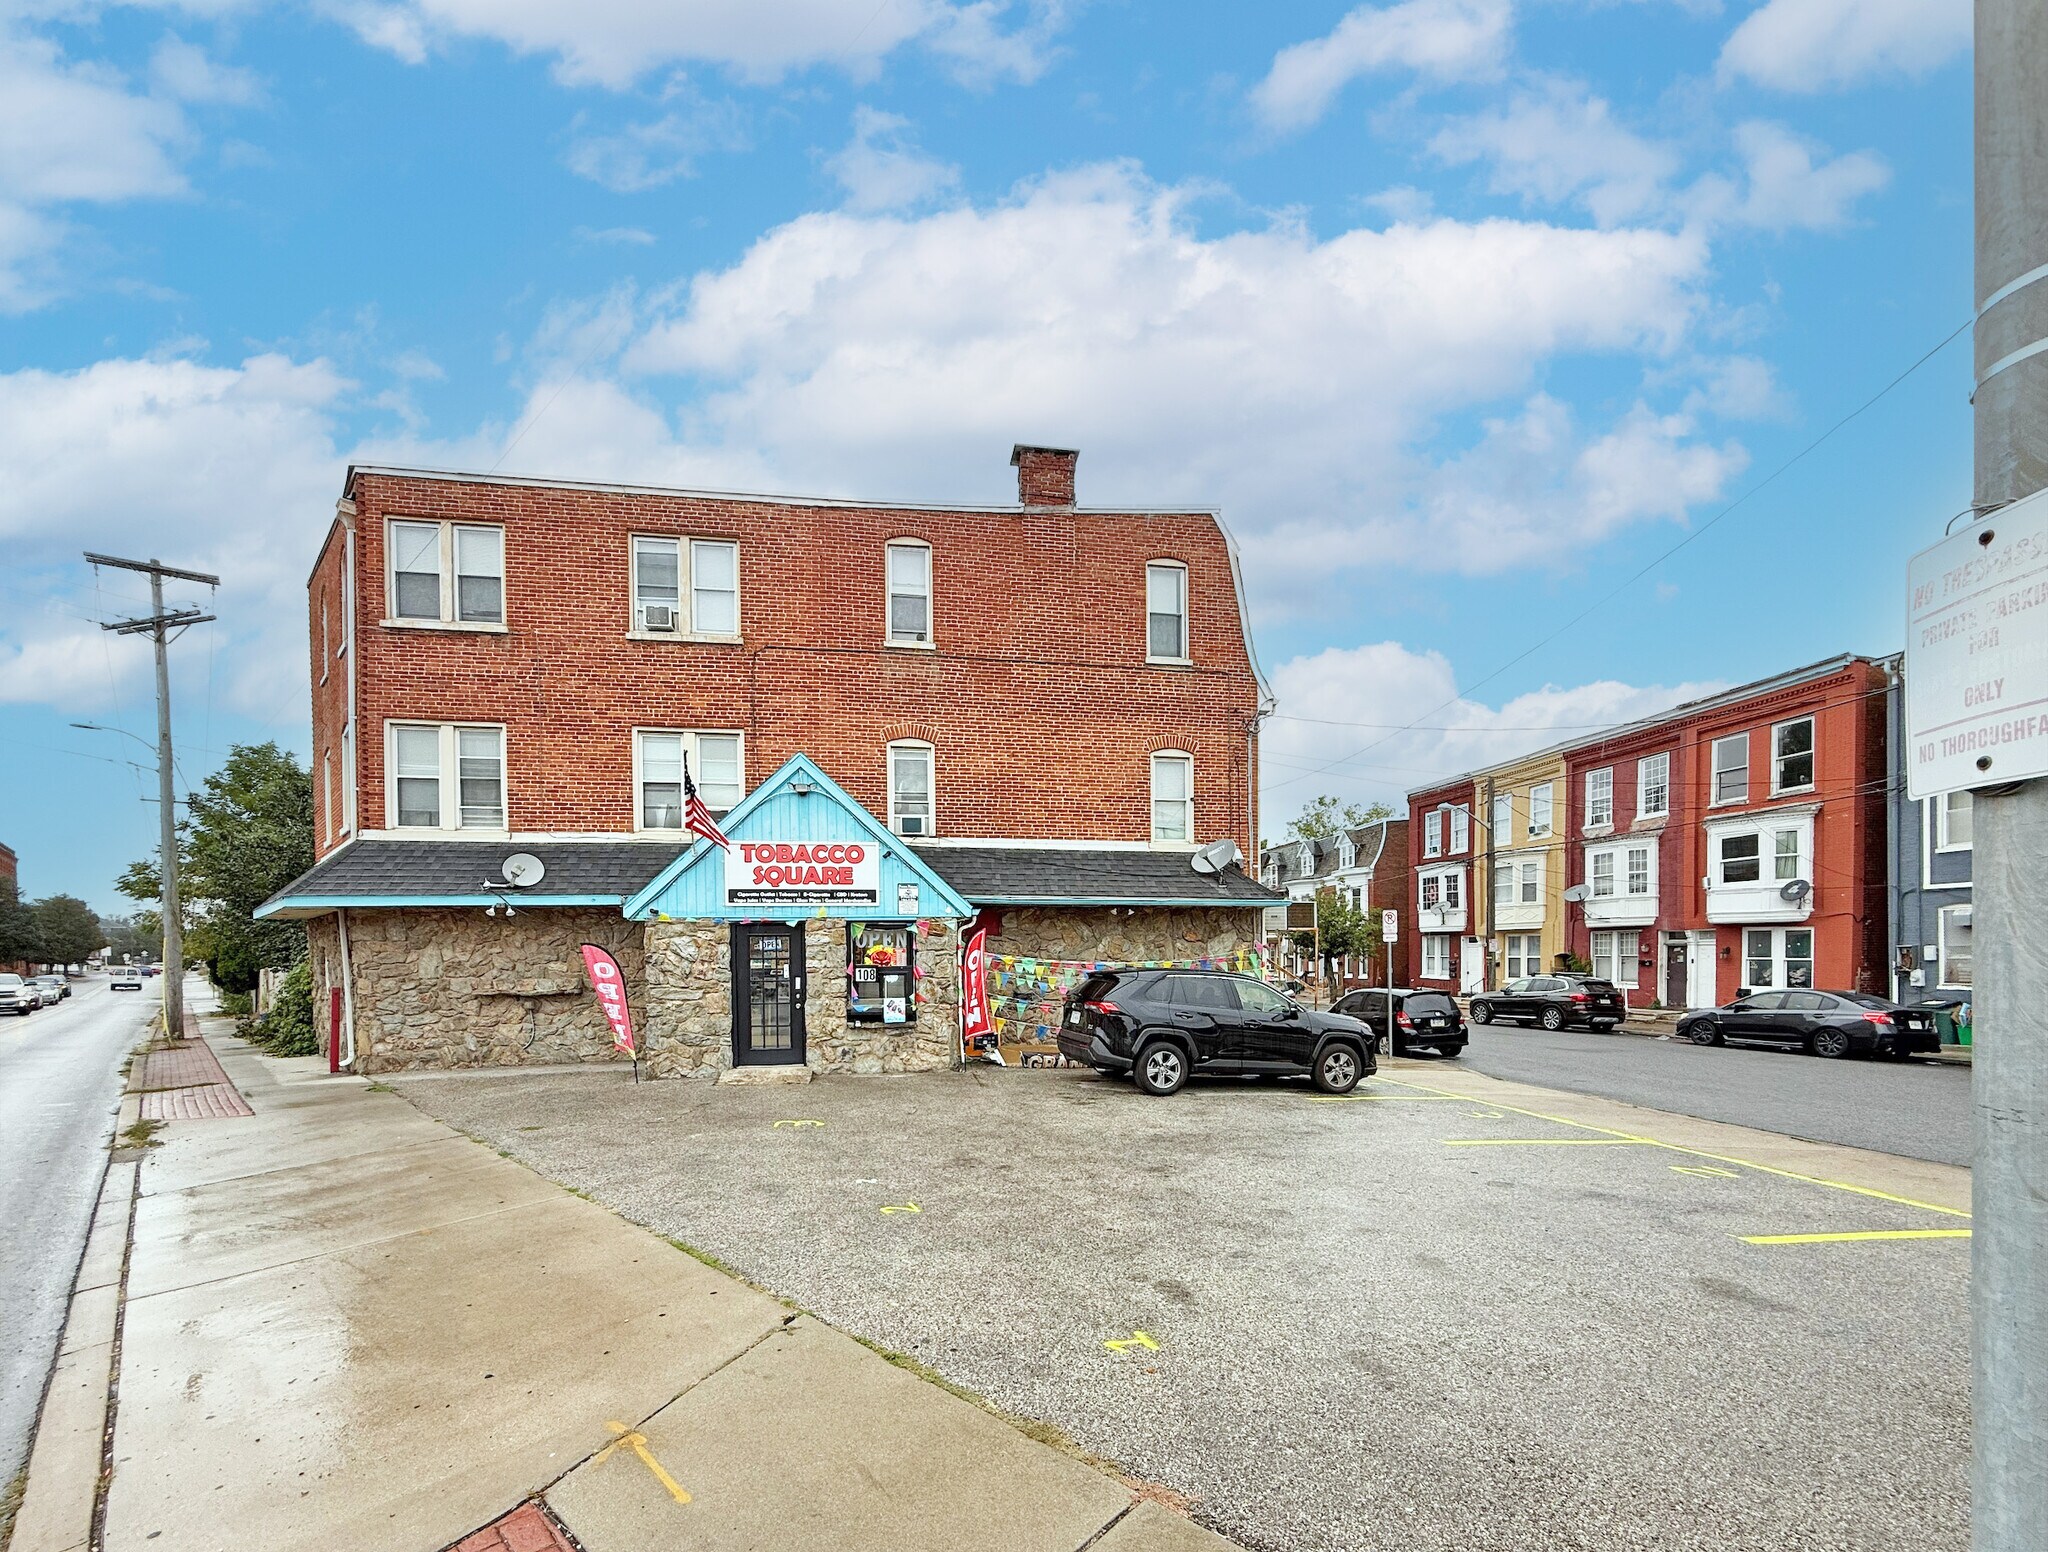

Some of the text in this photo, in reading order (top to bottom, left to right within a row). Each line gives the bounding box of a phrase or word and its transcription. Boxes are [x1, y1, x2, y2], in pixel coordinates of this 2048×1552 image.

[1912, 530, 2048, 612] NO TRESPASS
[1921, 606, 1978, 648] PRIVATE
[1968, 626, 2000, 654] FOR
[1963, 677, 2005, 708] ONLY
[1918, 742, 1935, 764] NO
[740, 843, 865, 864] TOBACCO
[753, 866, 854, 887] SQUARE
[855, 931, 907, 948] OPEN
[857, 968, 876, 981] 108
